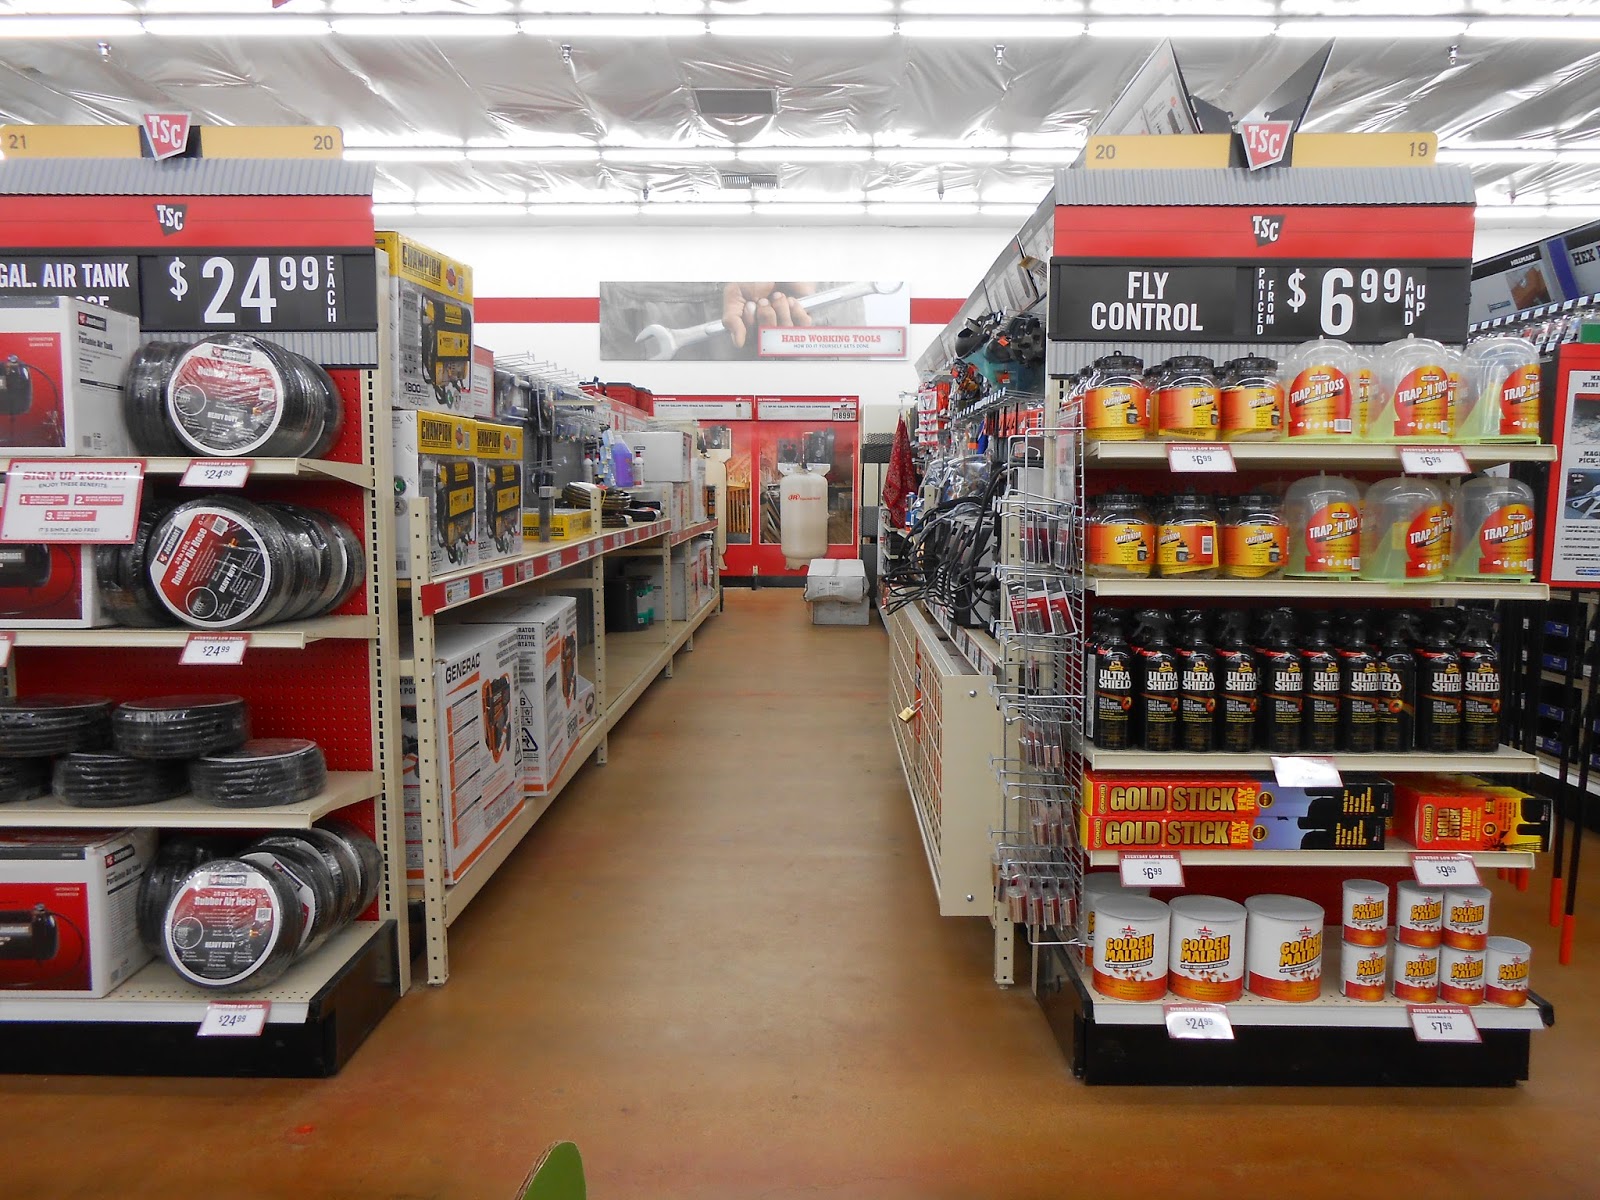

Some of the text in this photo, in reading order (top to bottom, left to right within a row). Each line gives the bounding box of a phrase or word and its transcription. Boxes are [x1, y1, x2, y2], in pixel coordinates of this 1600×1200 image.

[149, 115, 181, 149] TSC
[9, 135, 26, 149] 21
[313, 135, 334, 151] 20
[1248, 125, 1281, 158] TSC
[1409, 141, 1429, 157] 19
[1095, 144, 1117, 160] 20
[156, 204, 184, 231] TSC
[1252, 215, 1280, 242] TSC
[402, 245, 441, 279] CHAMPION
[1571, 248, 1596, 266] HEX
[0, 263, 130, 288] GAL. AIR TANK
[1127, 271, 1169, 299] FLY
[1091, 302, 1203, 331] CONTROL
[781, 334, 881, 343] HARD WORKING TOOLS
[1291, 387, 1311, 404] TRAP
[1324, 378, 1344, 393] TOSS
[1398, 387, 1423, 403] TRAP
[1503, 384, 1526, 401] TRAP
[421, 419, 452, 442] CHAMPION
[23, 471, 56, 480] SIGN
[60, 471, 75, 480] UP
[79, 481, 107, 489] BENEFITS
[1310, 523, 1333, 539] TRAP
[1410, 528, 1432, 545] TRAP
[1484, 526, 1509, 541] TRAP
[171, 558, 191, 587] Rubber
[194, 527, 208, 547] Hose
[445, 653, 481, 684] GENERAC
[1099, 669, 1131, 680] ULTRA
[1148, 671, 1179, 681] ULTRA
[1183, 671, 1215, 681] ULTRA
[1227, 671, 1257, 682] ULTRA
[1314, 671, 1340, 682] ULTR
[1098, 679, 1132, 689] SHIELD
[1352, 672, 1378, 682] ULTR
[1466, 672, 1499, 683] ULTRA
[1146, 681, 1179, 691] SHIELD
[1182, 681, 1216, 691] SHIELD
[1313, 681, 1340, 691] SHIEL
[1351, 681, 1378, 691] SHIEL
[1432, 681, 1461, 692] SHIEL
[1464, 681, 1500, 692] SHIELD
[1110, 786, 1236, 811] GOLD STICK
[1237, 787, 1247, 811] FLY
[1247, 787, 1256, 810] TRAP
[1437, 808, 1450, 837] GOLD
[1449, 808, 1461, 837] STICK
[1461, 807, 1472, 841] FLY TRAP
[1105, 820, 1230, 845] GOLD STICK
[1231, 820, 1241, 843] FLY
[1240, 820, 1249, 843] TRAP
[194, 896, 257, 906] Rubber Air Hose
[1352, 900, 1385, 912] GOLDEN
[1352, 910, 1384, 920] MALRIN
[1450, 913, 1484, 923] MALRIN
[1451, 905, 1485, 916] GOLDEN
[1105, 933, 1155, 951] GOLDEN
[1181, 935, 1231, 951] GOLDEN
[1104, 947, 1154, 963] MALRIN
[1180, 947, 1230, 963] MALRIN
[1405, 966, 1437, 977] MALRIN
[1406, 957, 1437, 970] GOLDEN
[1451, 959, 1484, 970] GOLDEN
[1450, 967, 1483, 978] MALRIN
